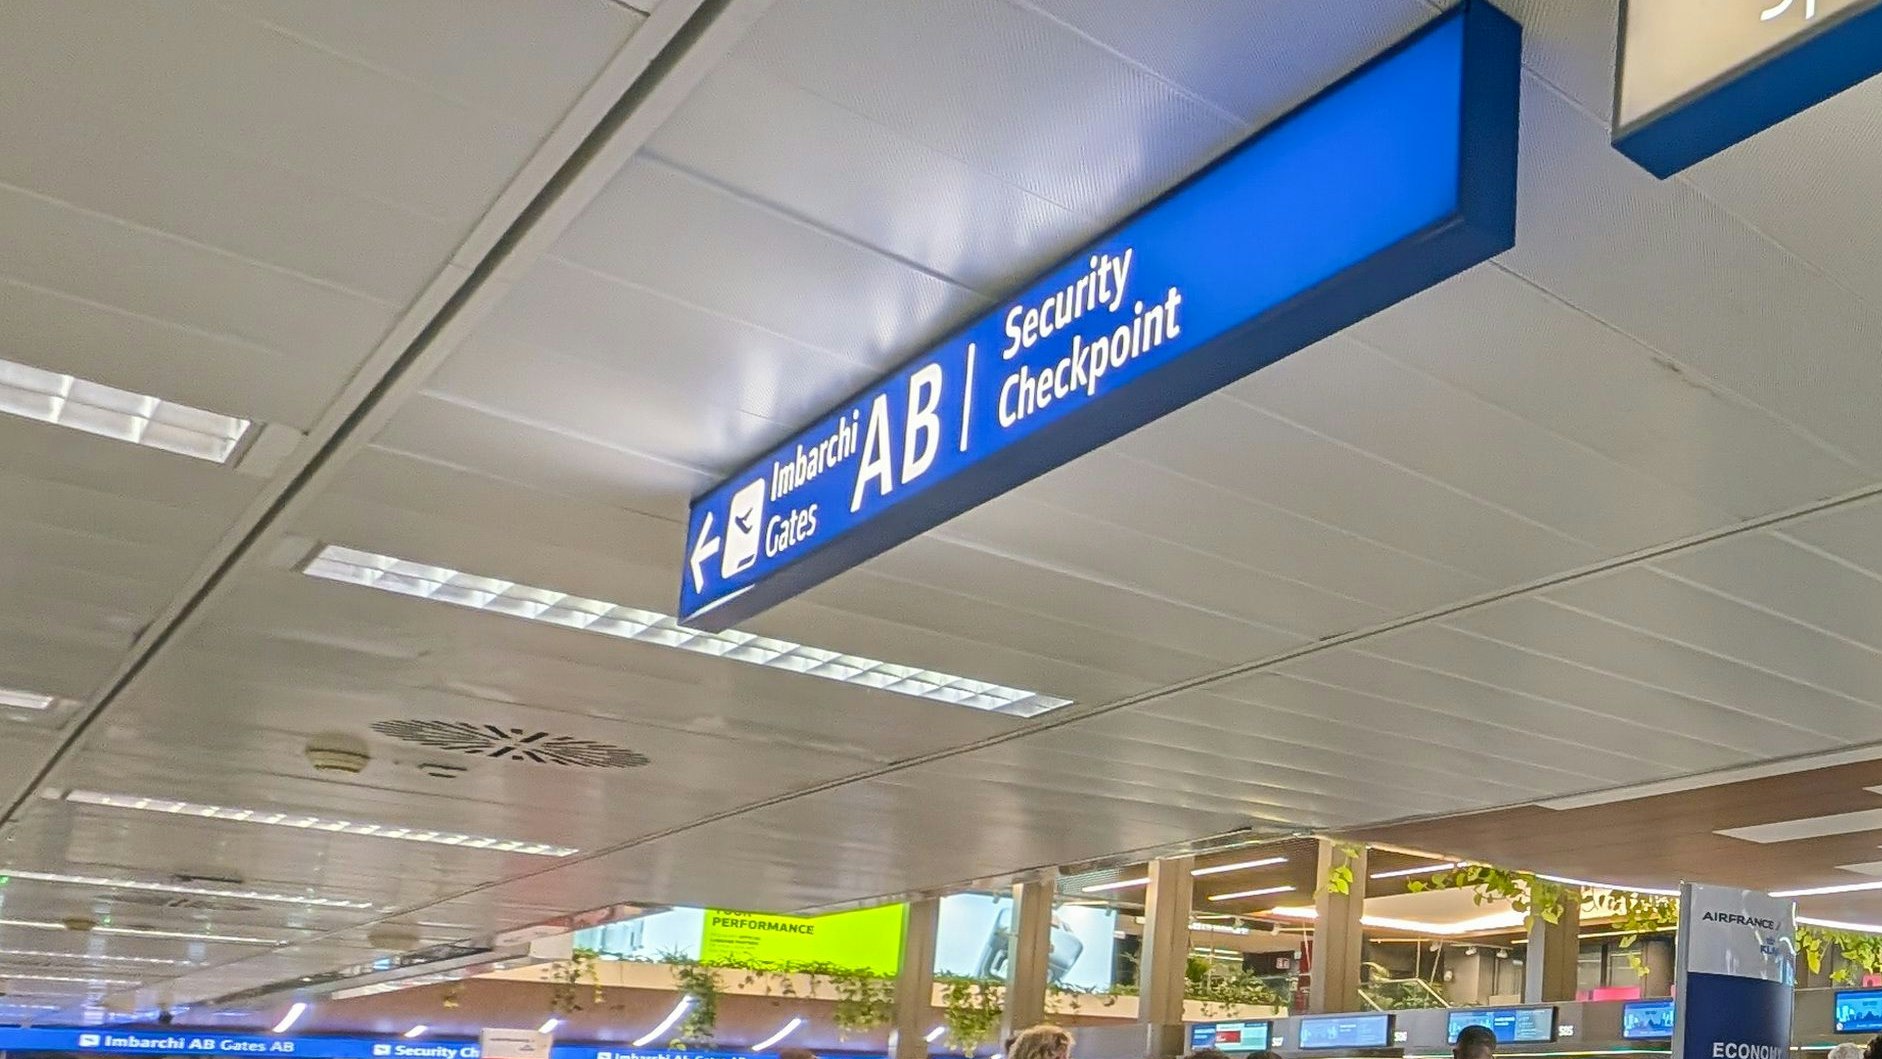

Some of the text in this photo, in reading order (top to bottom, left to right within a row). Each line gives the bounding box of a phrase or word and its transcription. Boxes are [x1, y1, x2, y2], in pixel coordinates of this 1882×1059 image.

[1003, 248, 1133, 360] Security
[998, 288, 1182, 428] Checkpoint
[770, 409, 858, 502] Imbarchi
[851, 362, 942, 513] AB
[765, 500, 817, 559] Gates
[712, 917, 815, 935] PERFORMANCE
[1702, 911, 1774, 931] AIRFRANCE
[104, 1035, 295, 1053] Imbarchi AB Gates AB
[394, 1045, 457, 1059] Security
